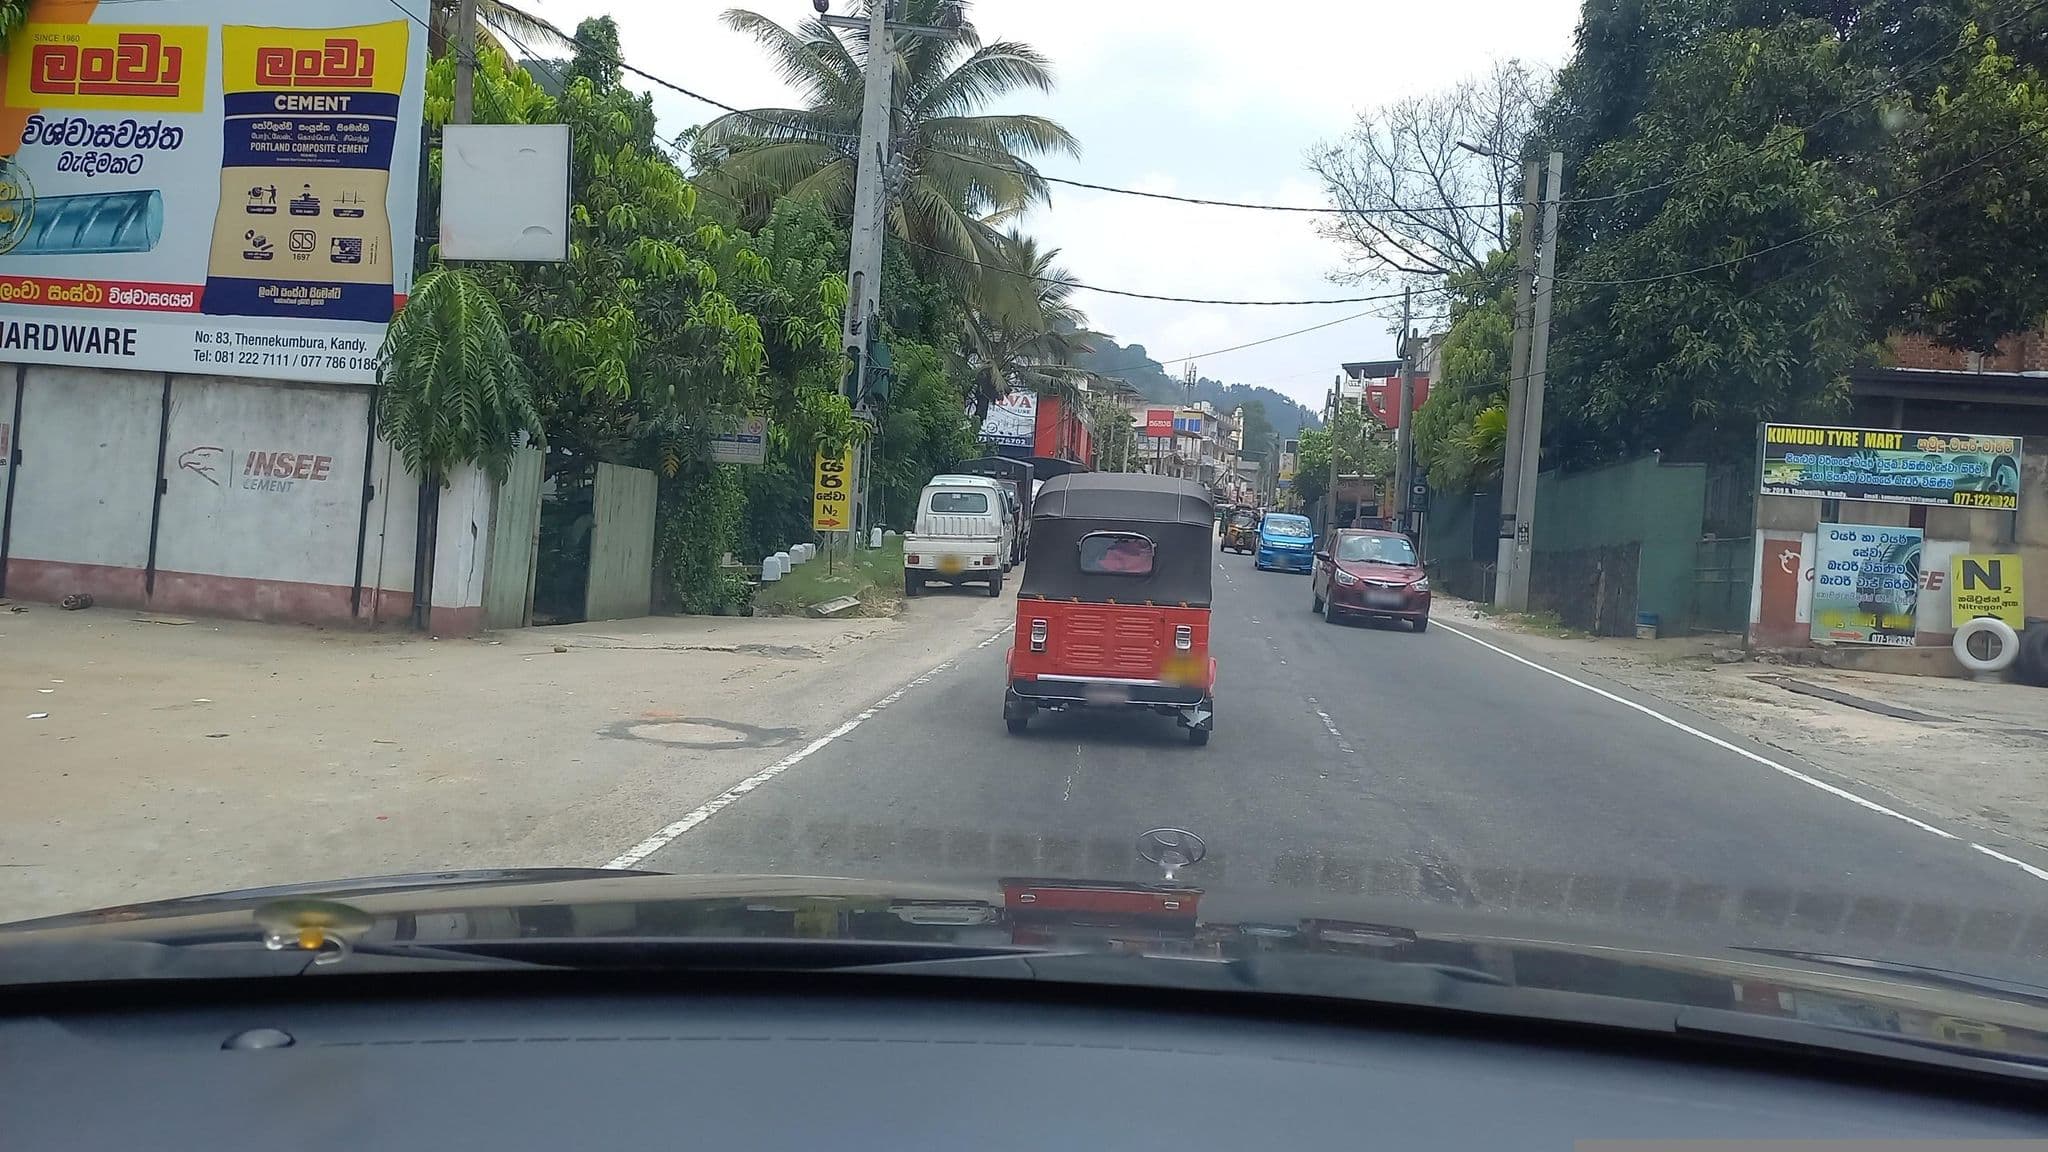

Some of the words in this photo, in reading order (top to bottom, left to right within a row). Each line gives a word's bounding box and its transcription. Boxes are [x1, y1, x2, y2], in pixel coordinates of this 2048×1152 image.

[33, 34, 59, 42] SINCE
[62, 34, 80, 43] 1960
[274, 95, 351, 111] CEMENT
[21, 115, 184, 150] විශ්වාසවන්ත
[250, 142, 290, 152] PORTLAND
[292, 143, 335, 153] COMPOSITE
[337, 144, 369, 154] CEMENT
[293, 253, 311, 261] 1697
[0, 321, 138, 356] ARDWARE
[195, 330, 213, 344] No:
[216, 332, 232, 346] 83,
[235, 332, 327, 350] Thennekumbura,
[330, 337, 368, 352] Kandy.
[193, 350, 212, 362] Tel:
[214, 350, 234, 363] 081
[239, 352, 259, 365] 222
[262, 353, 289, 366] 7111
[300, 355, 322, 368] 077
[326, 356, 346, 369] 786
[349, 357, 378, 371] 0186
[1767, 427, 1825, 446] KUMUDU
[1827, 431, 1859, 448] TYRE
[1864, 432, 1903, 450] MART
[243, 451, 332, 481] INSEE
[242, 479, 294, 493] CEMENT
